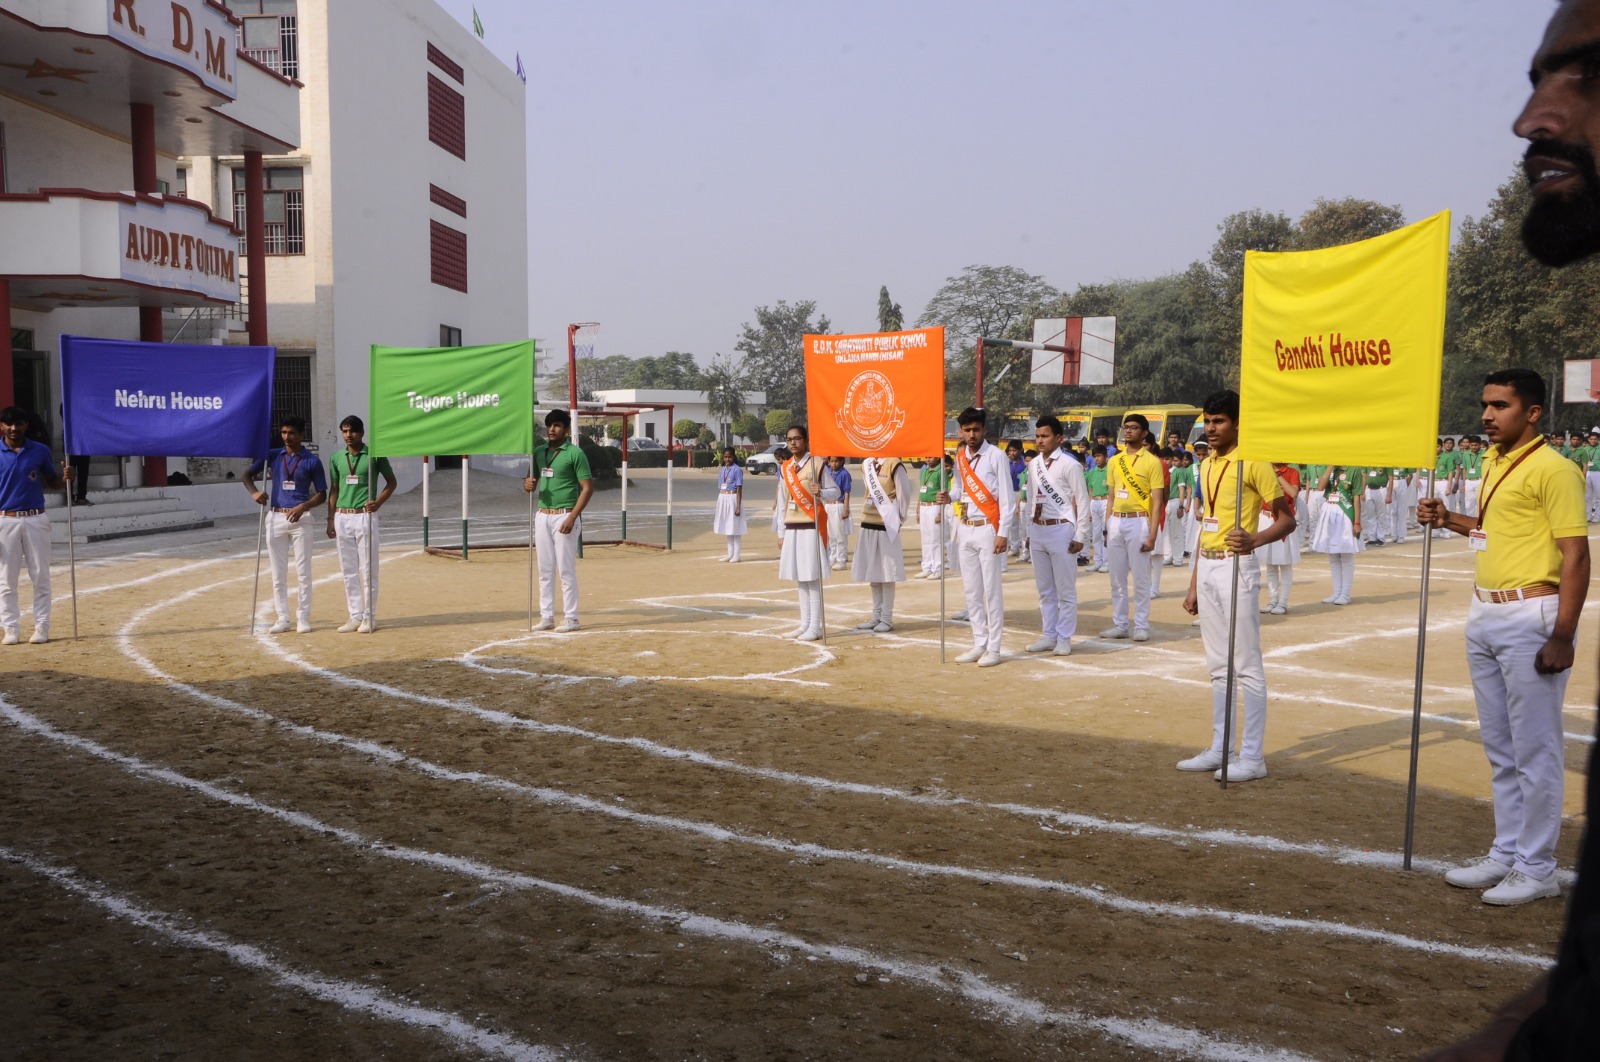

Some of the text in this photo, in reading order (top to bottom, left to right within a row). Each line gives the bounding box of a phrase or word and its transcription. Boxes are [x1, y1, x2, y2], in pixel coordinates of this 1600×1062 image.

[126, 222, 235, 283] AUDITOIUM
[874, 335, 899, 351] PUBLIC
[900, 332, 928, 350] SCHOOL
[1275, 332, 1391, 371] Gandhi House
[115, 389, 223, 410] Nehru House
[407, 391, 500, 413] Tagore House
[868, 473, 878, 490] HEAD
[873, 489, 885, 505] GIRL
[965, 474, 989, 504] HEAD BOY
[1040, 475, 1054, 494] HEAD
[1051, 492, 1065, 507] BOY
[1118, 456, 1148, 501] HOUSE CAPTAIN
[791, 483, 812, 511] HEAD GIRL
